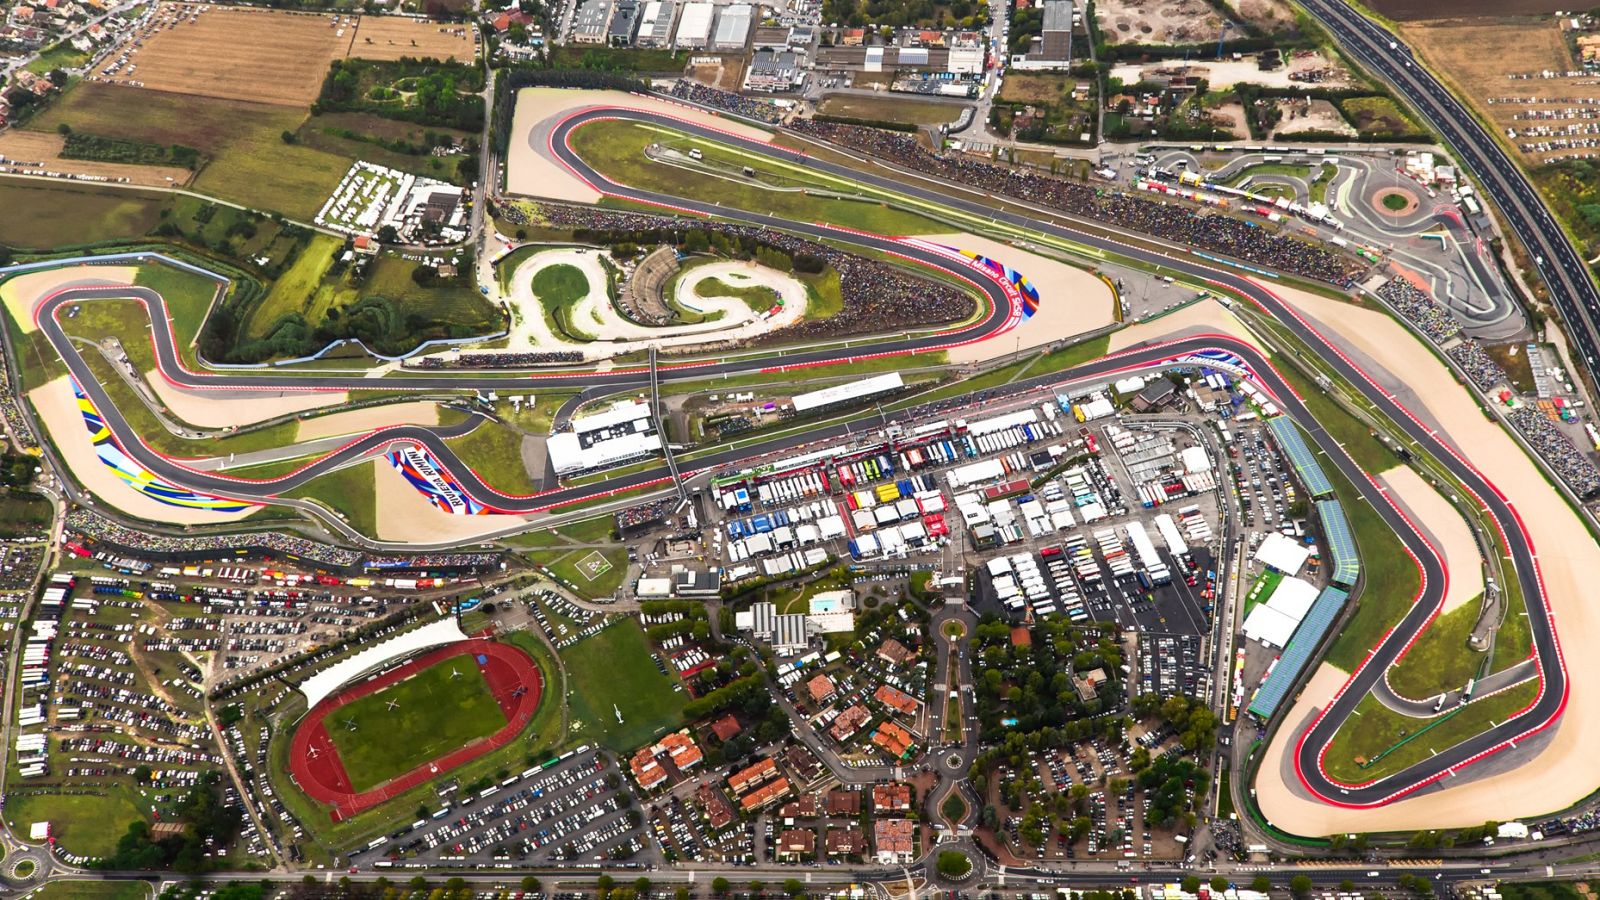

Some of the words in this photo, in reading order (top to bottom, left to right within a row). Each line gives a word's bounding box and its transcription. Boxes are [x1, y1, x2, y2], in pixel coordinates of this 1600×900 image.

[972, 260, 999, 279] Misano
[999, 278, 1018, 297] Circuit
[407, 451, 436, 476] RIMINI
[432, 477, 464, 507] RIVIERA
